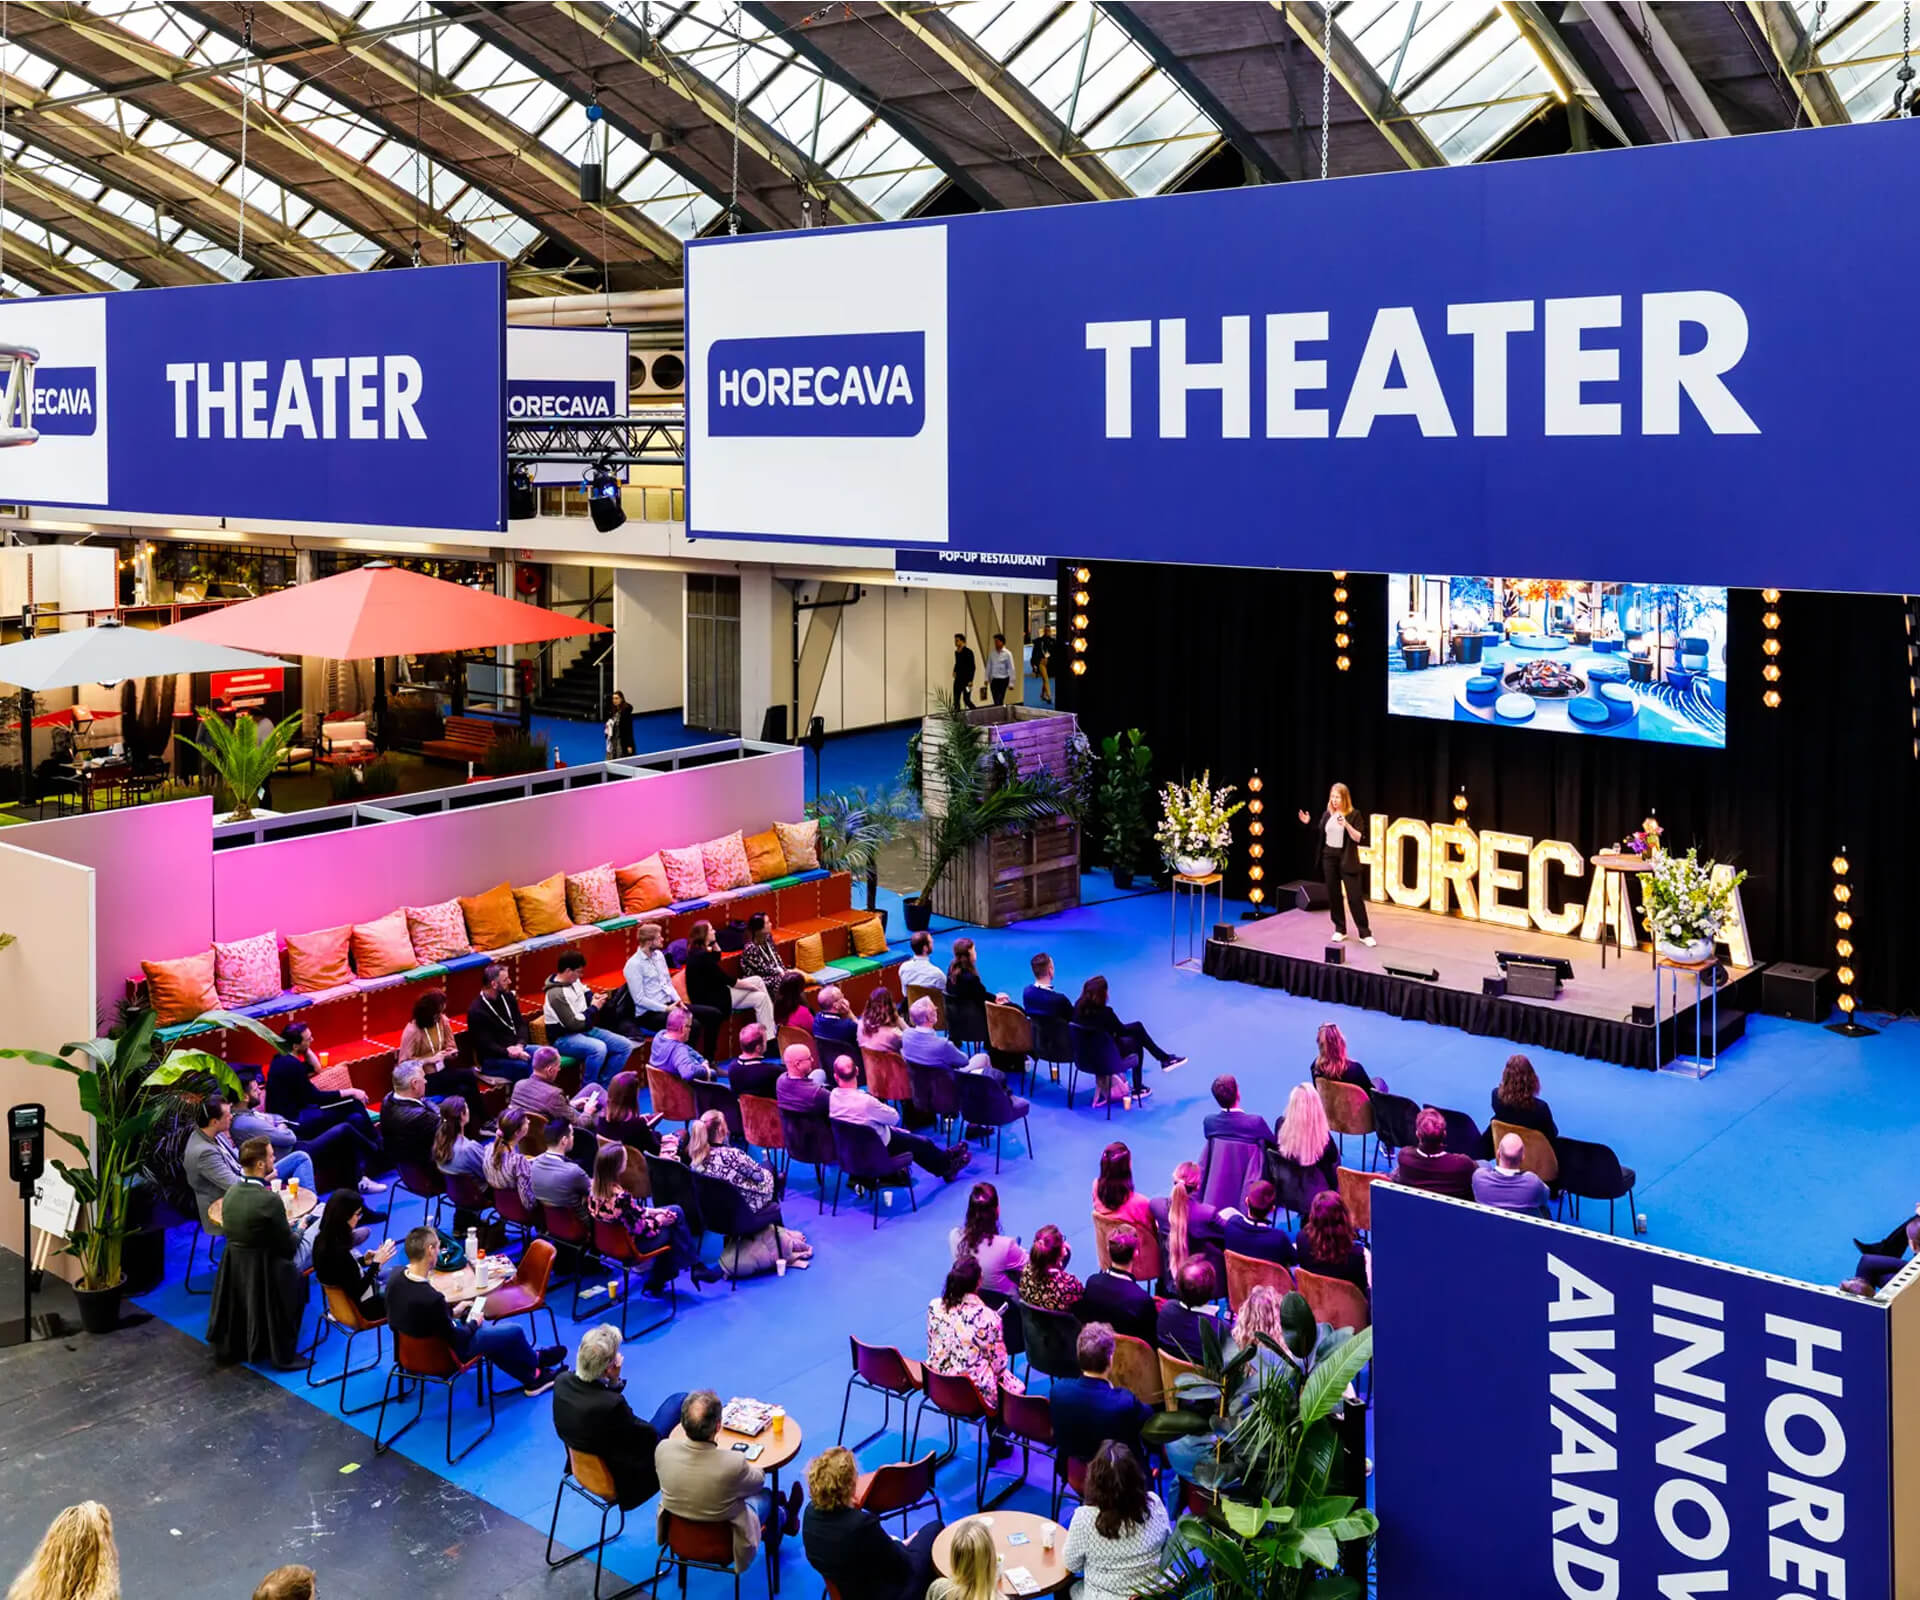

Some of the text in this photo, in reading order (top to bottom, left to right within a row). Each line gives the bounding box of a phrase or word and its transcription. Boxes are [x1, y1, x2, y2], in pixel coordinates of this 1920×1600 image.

[166, 354, 427, 440] THEATER
[507, 395, 610, 417] ORECAVA
[719, 364, 914, 407] HORECAVA
[1085, 290, 1761, 439] THEATER
[938, 551, 1047, 567] POP-UP RESTAURANT
[1546, 1252, 1620, 1600] AWARD
[1764, 1311, 1848, 1600] HORE
